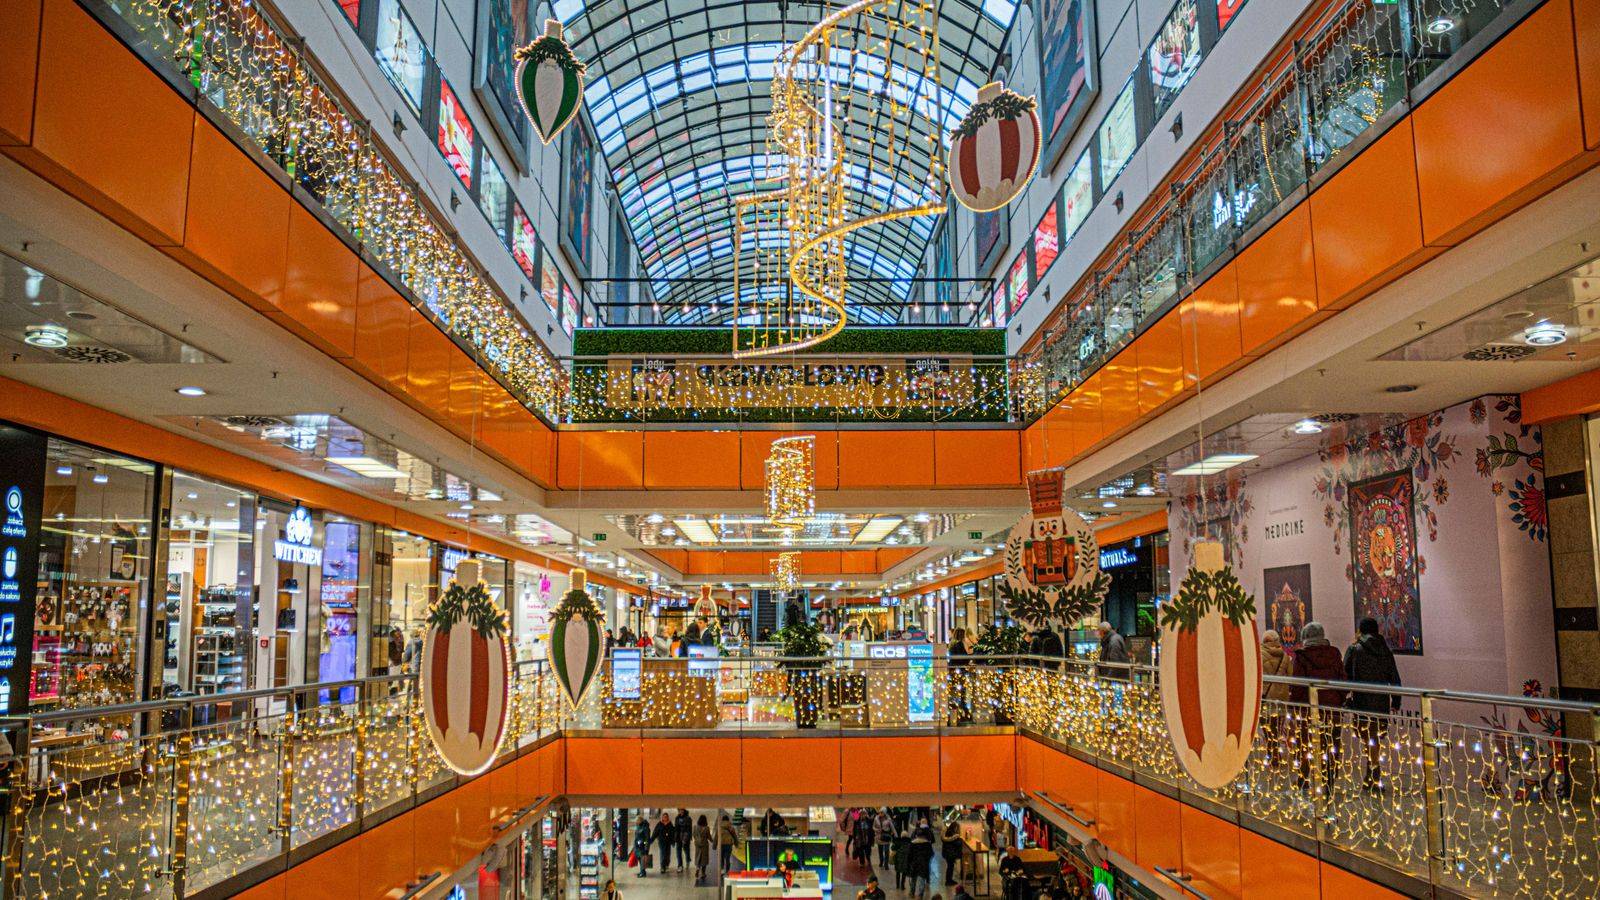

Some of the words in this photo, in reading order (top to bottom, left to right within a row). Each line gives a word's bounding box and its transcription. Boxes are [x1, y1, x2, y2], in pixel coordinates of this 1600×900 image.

[1264, 519, 1304, 541] MEDICINE
[274, 541, 322, 566] WITTCHEN
[322, 592, 346, 601] DAYS
[870, 646, 906, 658] IQOS
